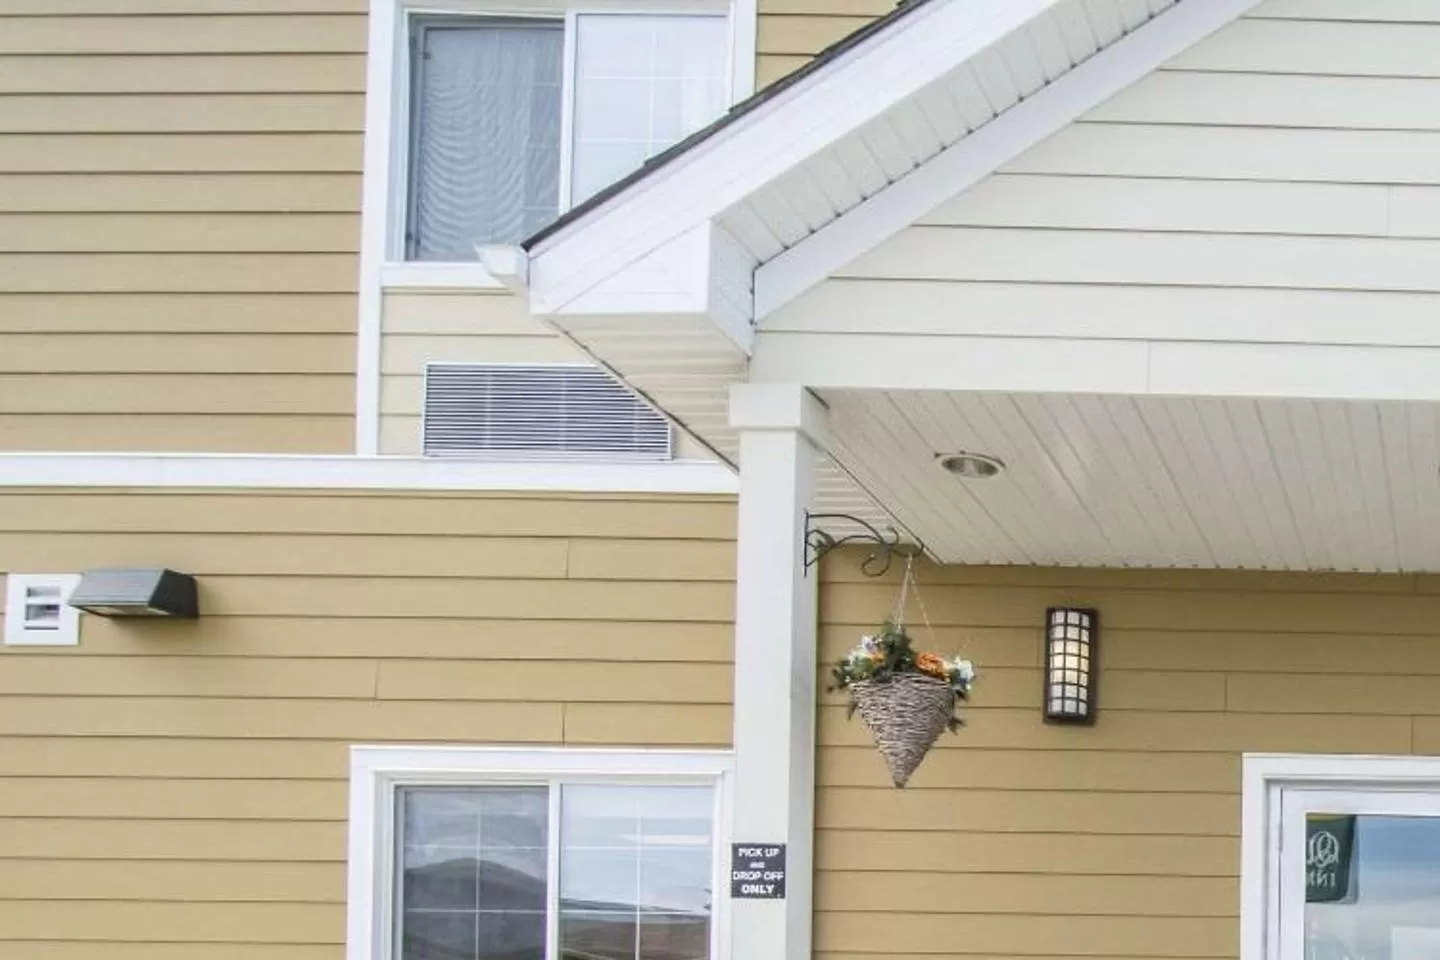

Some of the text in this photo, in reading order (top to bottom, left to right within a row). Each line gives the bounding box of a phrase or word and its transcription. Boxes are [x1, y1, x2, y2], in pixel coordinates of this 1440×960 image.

[738, 848, 780, 857] PICK UP
[732, 871, 784, 880] DROP OFF
[741, 884, 775, 894] ONLY
